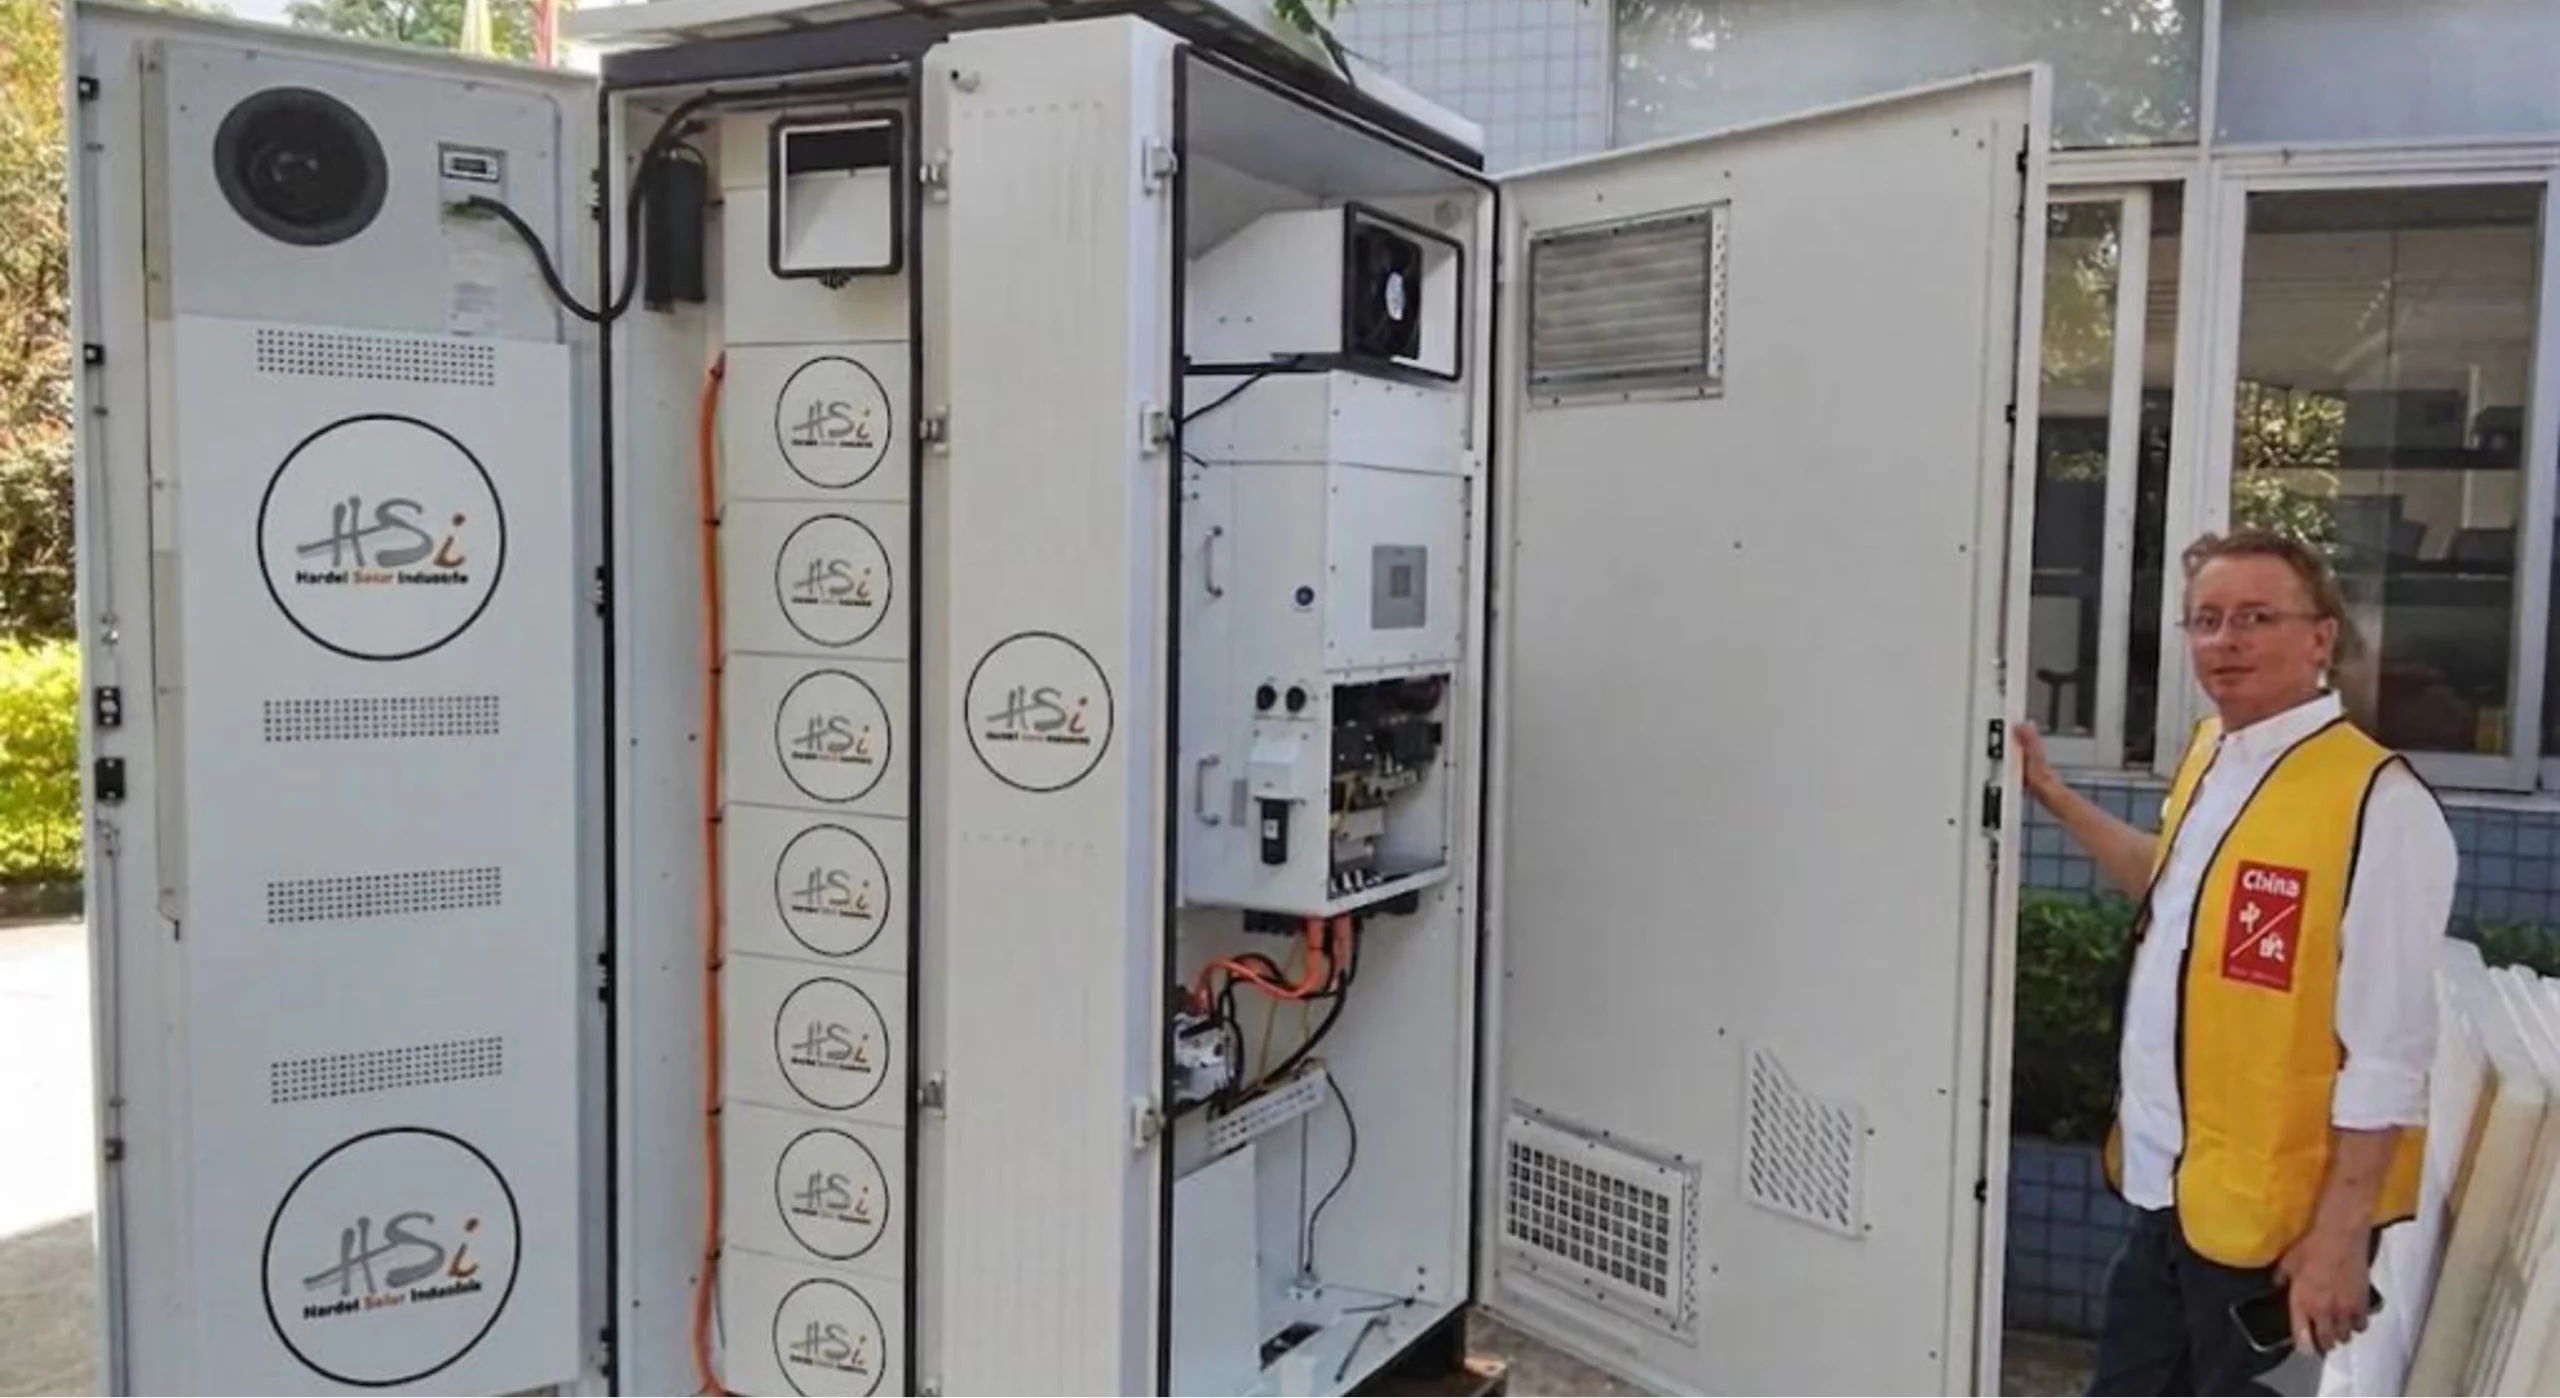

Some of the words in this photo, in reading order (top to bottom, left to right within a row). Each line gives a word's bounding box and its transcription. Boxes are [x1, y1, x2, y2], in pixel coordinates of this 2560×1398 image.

[792, 400, 871, 439] HSi
[297, 495, 467, 568] HSi
[792, 559, 871, 599] HSi
[986, 685, 1088, 733] HSi
[792, 714, 870, 754] HSi
[792, 867, 869, 910] HSi
[2243, 869, 2299, 898] China
[303, 1212, 479, 1296] HSi
